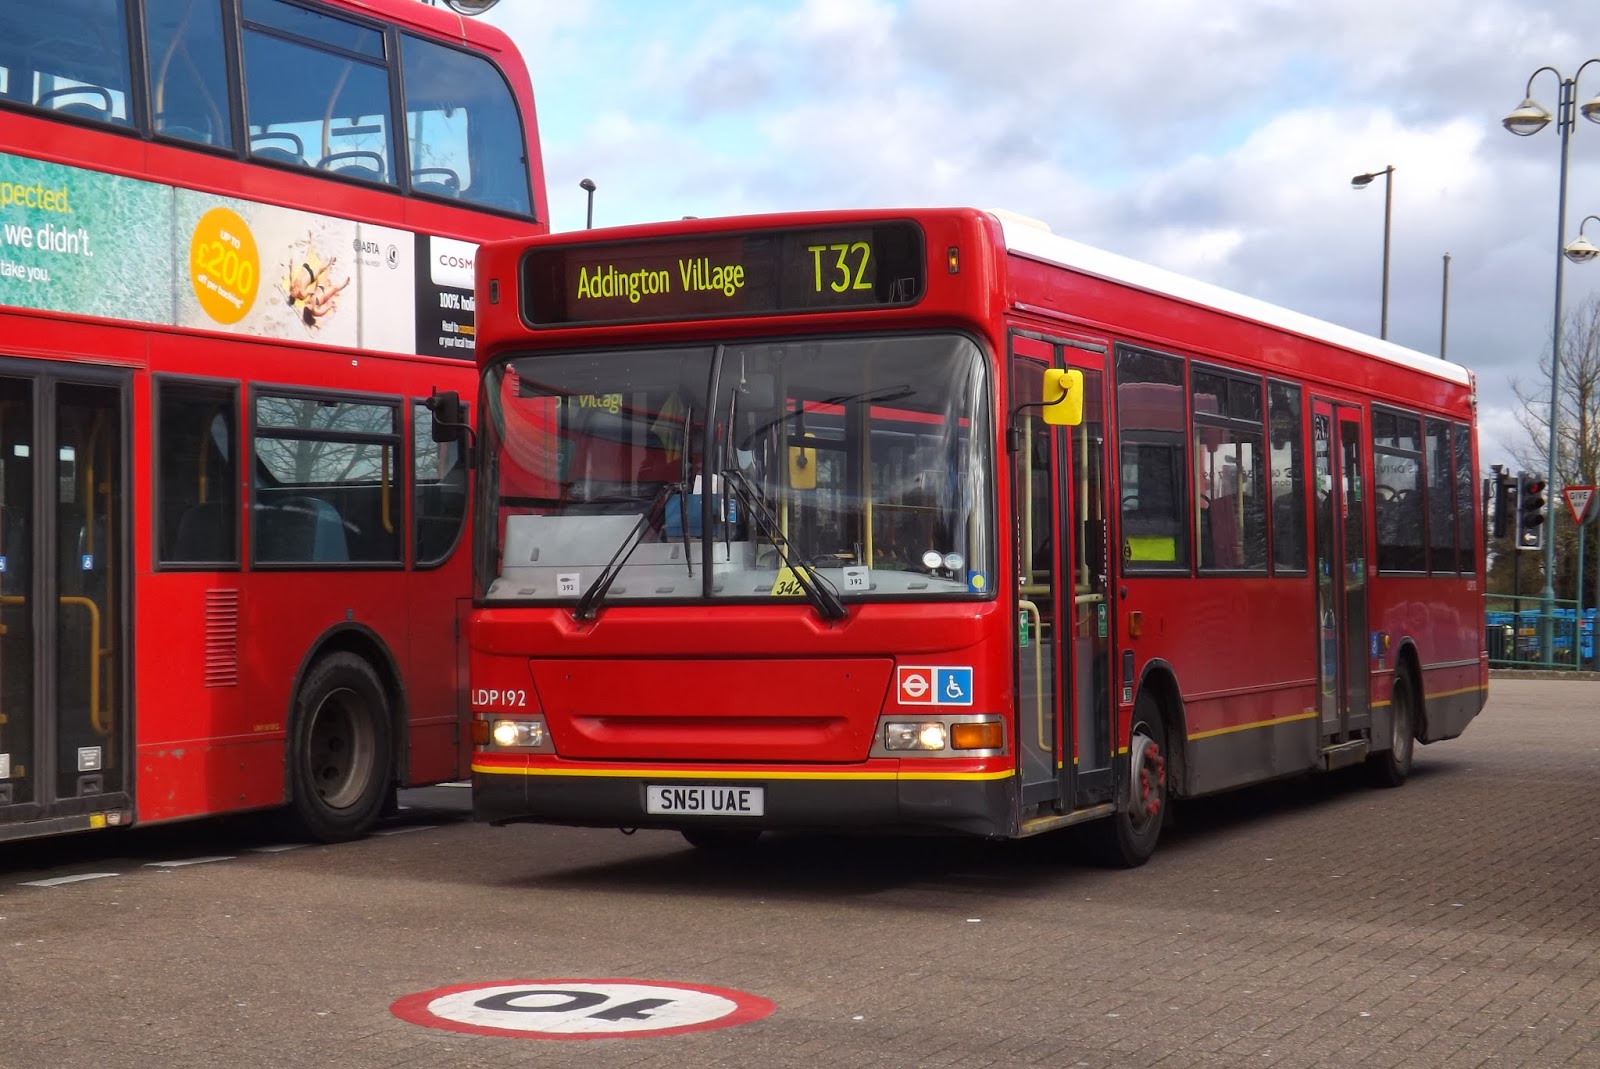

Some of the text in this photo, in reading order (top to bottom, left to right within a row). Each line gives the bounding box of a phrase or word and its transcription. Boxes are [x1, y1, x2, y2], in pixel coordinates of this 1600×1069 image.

[4, 222, 94, 257] we didn't.
[361, 241, 380, 255] ABTA
[196, 240, 253, 295] £200
[439, 254, 475, 270] COSM
[808, 241, 873, 293] T32
[0, 260, 51, 283] take you.
[577, 257, 745, 304] Addington Village
[439, 292, 460, 310] 100%
[1570, 491, 1588, 500] GIVE
[776, 581, 801, 595] 342
[849, 578, 863, 586] 392
